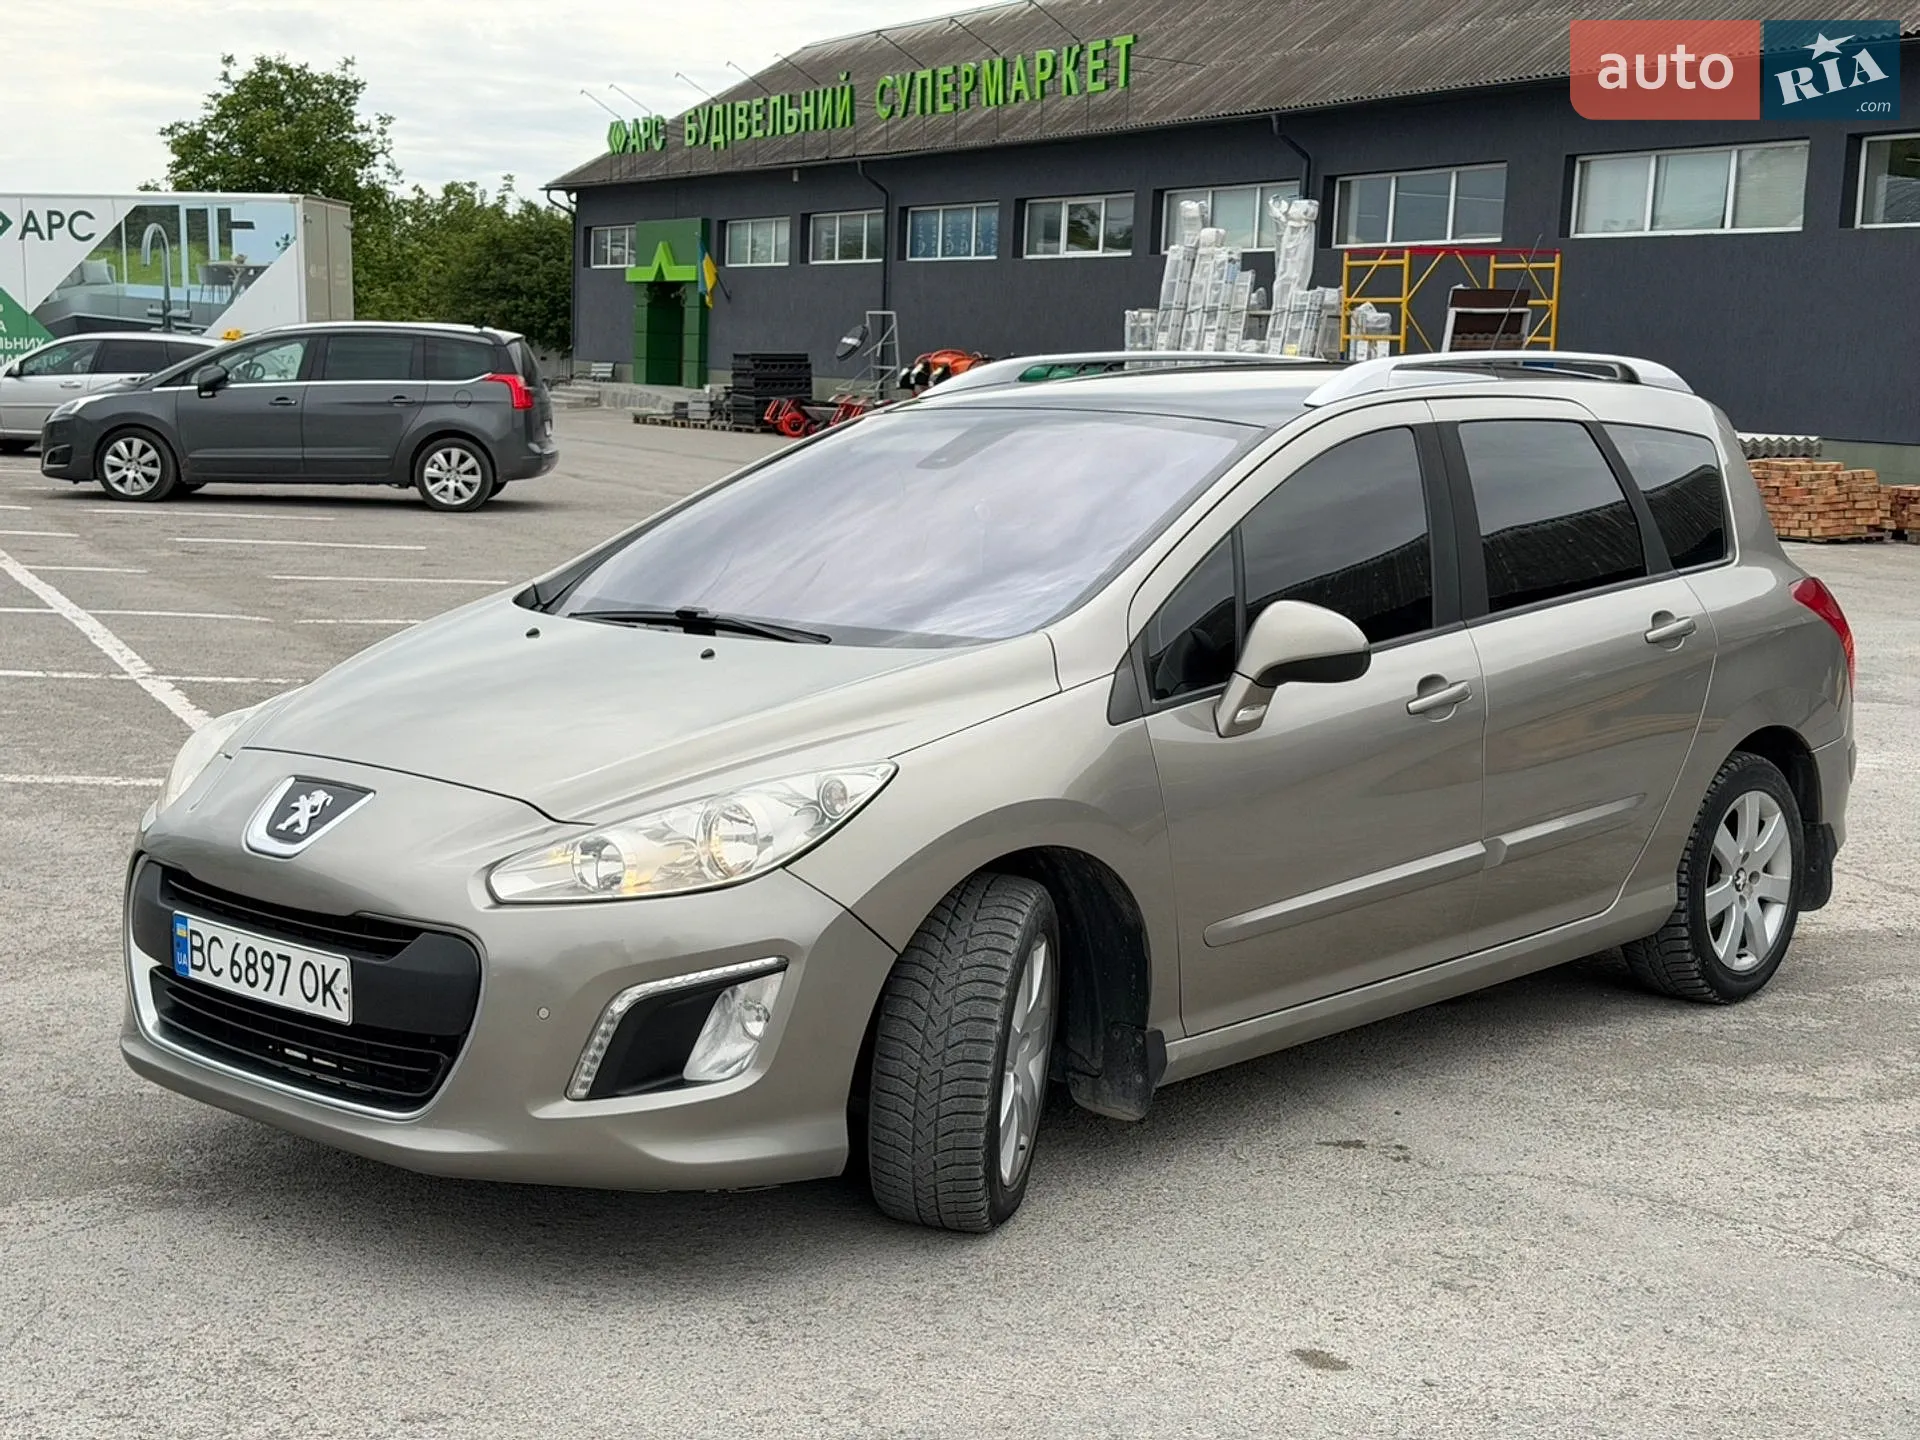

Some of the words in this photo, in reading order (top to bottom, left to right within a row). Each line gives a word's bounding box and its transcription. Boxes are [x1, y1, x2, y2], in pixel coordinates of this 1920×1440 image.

[629, 115, 666, 153] АРС
[684, 71, 857, 150] БУДІВЕЛЬНИЙ
[875, 34, 1137, 120] СУПЕРМАРКЕТ
[18, 210, 96, 242] АРС
[177, 951, 188, 967] UA
[230, 942, 292, 996] 6897
